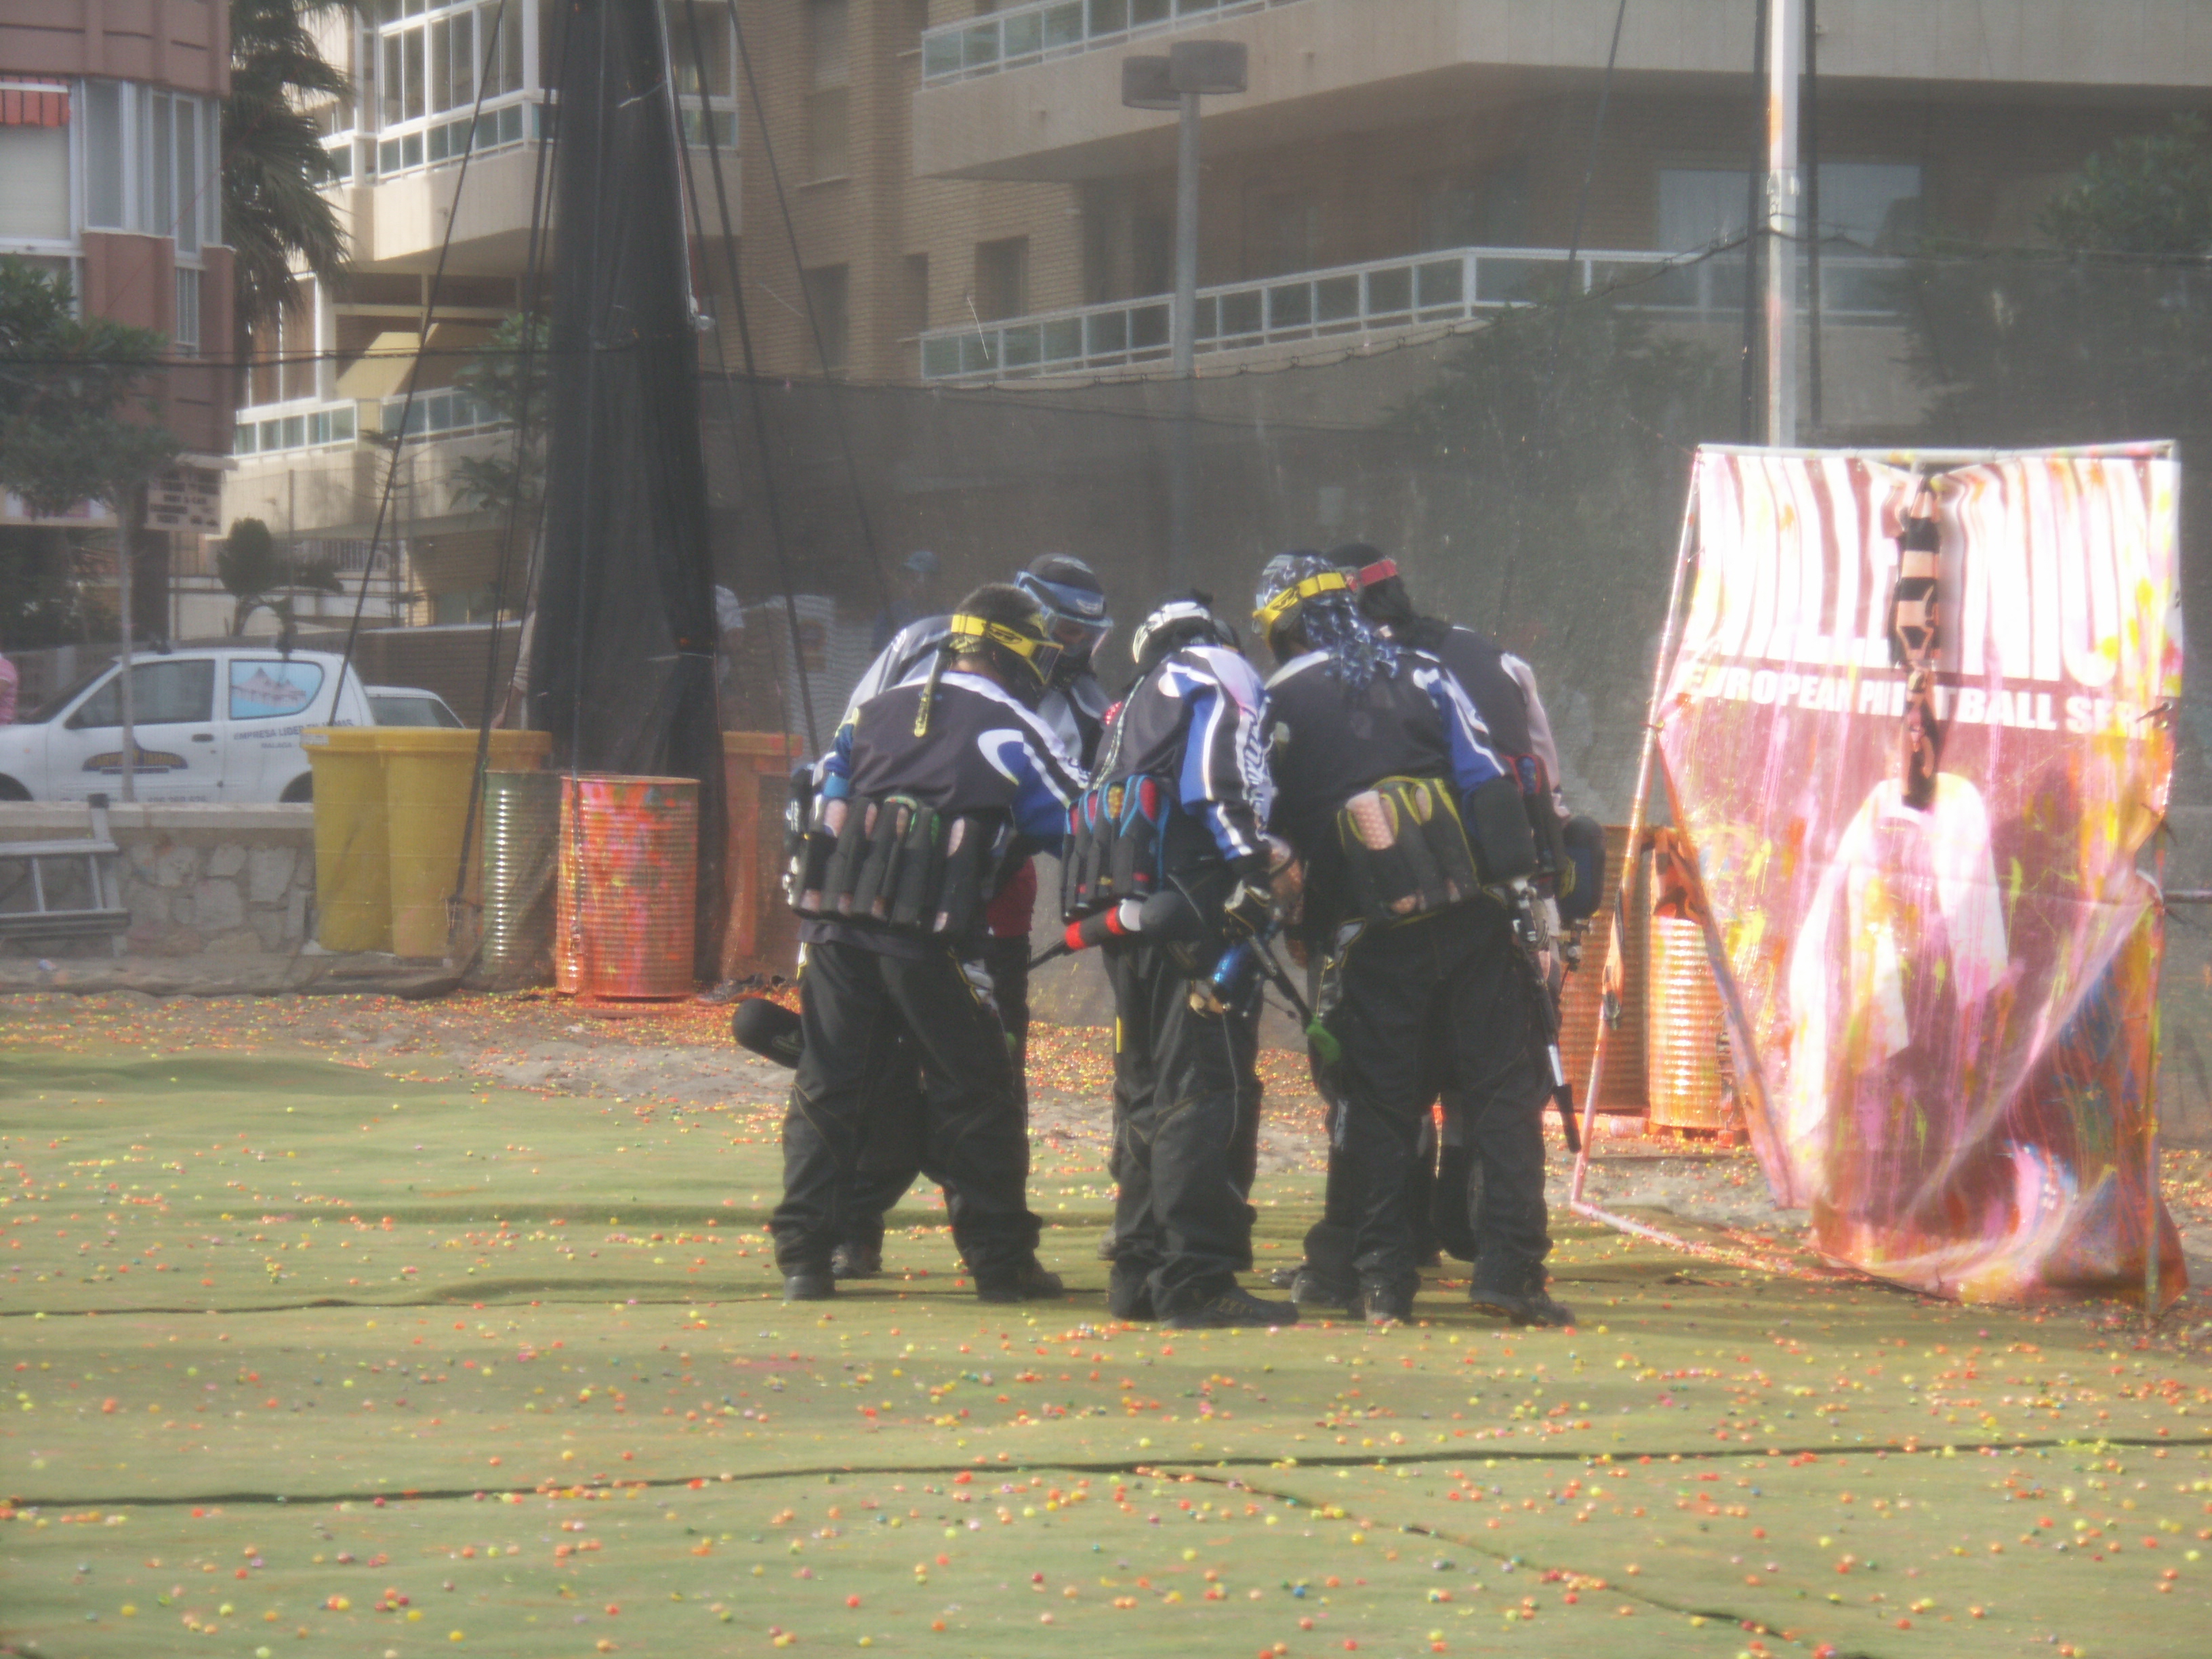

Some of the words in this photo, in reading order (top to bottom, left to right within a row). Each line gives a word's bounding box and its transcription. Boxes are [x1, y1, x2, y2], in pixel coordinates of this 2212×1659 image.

[1686, 453, 2180, 694] MILLENIUM
[1675, 661, 1851, 713] EUROPEAN
[1858, 680, 2056, 731] PAITBALL
